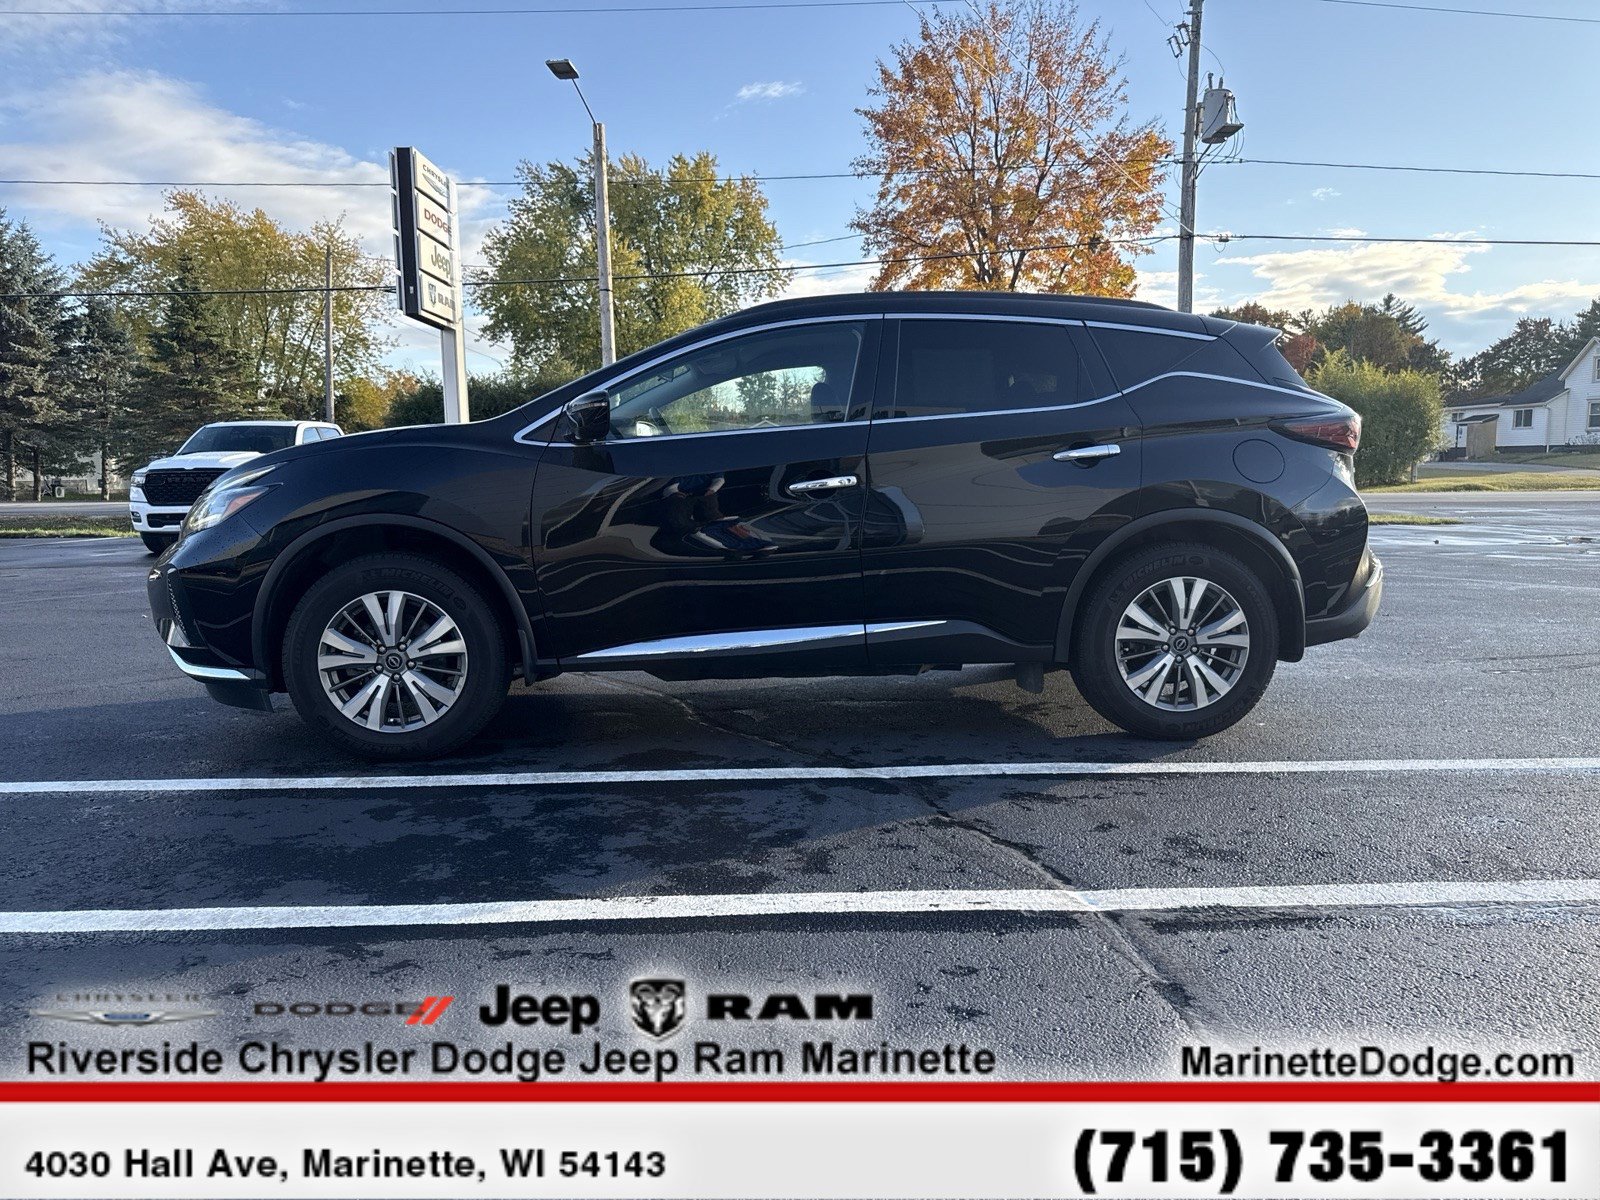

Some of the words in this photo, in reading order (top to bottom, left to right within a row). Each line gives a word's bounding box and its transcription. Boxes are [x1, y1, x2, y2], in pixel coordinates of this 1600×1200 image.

[424, 208, 452, 237] DODGE
[430, 245, 451, 278] Jeep
[380, 567, 455, 600] MICHELIN
[1121, 554, 1187, 589] MICHELIN
